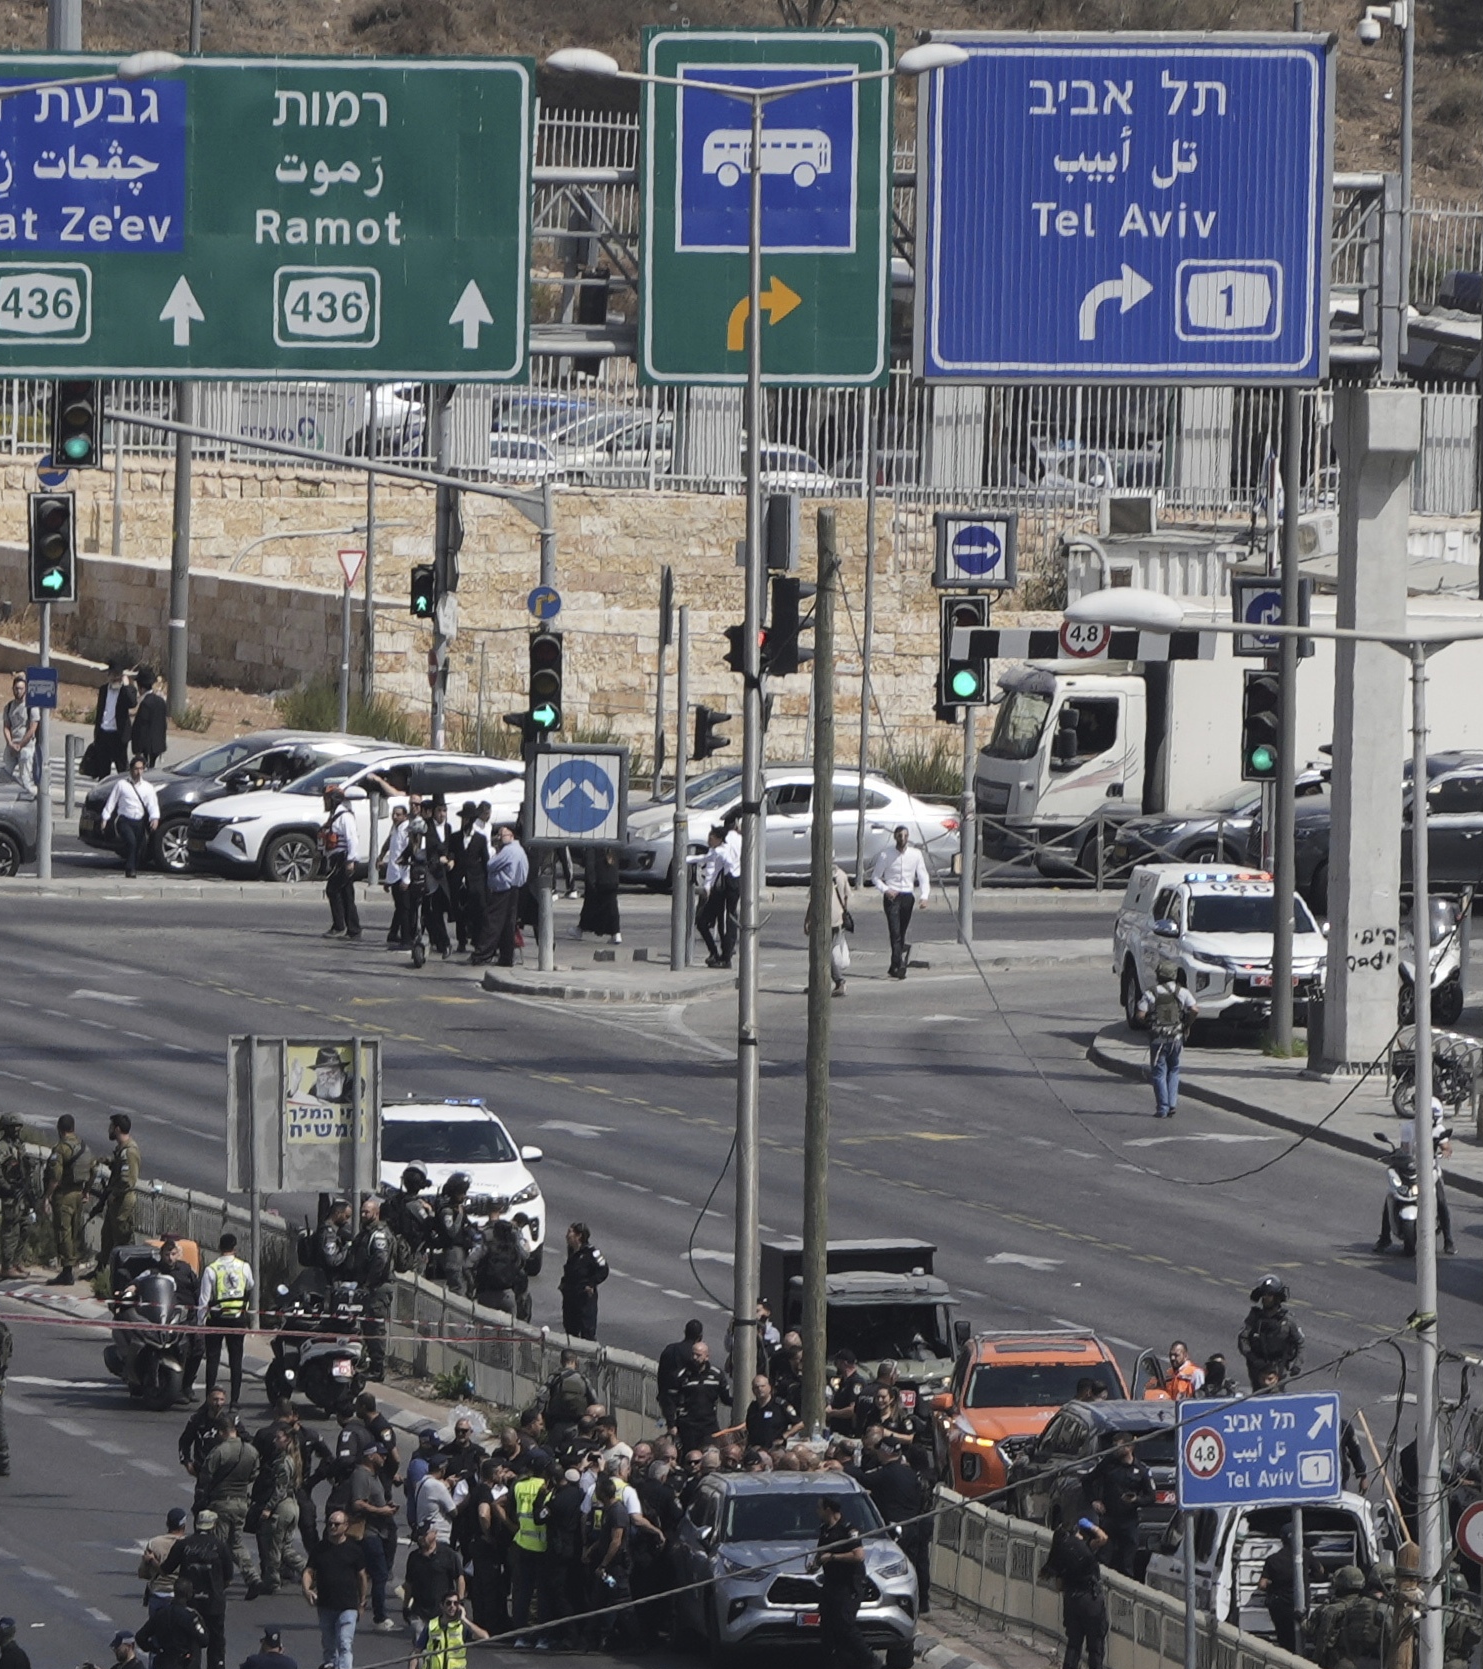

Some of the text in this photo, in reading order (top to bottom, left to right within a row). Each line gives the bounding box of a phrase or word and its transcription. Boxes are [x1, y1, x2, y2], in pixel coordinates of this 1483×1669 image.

[34, 87, 159, 129] גבעת
[273, 89, 389, 129] רמות
[1028, 70, 1227, 117] תל אביב
[1053, 125, 1199, 189] تل أبيب
[60, 205, 172, 242] Ze'ev
[255, 208, 403, 246] Ramot
[1032, 201, 1218, 238] Tel Aviv
[0, 286, 74, 321] 436
[289, 290, 365, 324] 436
[1218, 284, 1237, 317] 1
[1070, 626, 1099, 644] 4.8
[289, 1105, 334, 1122] המלך
[1223, 1409, 1296, 1434] תל אביב
[1194, 1445, 1216, 1462] 4.8
[1312, 1462, 1320, 1477] 1
[1227, 1470, 1295, 1488] Tel Aviv
